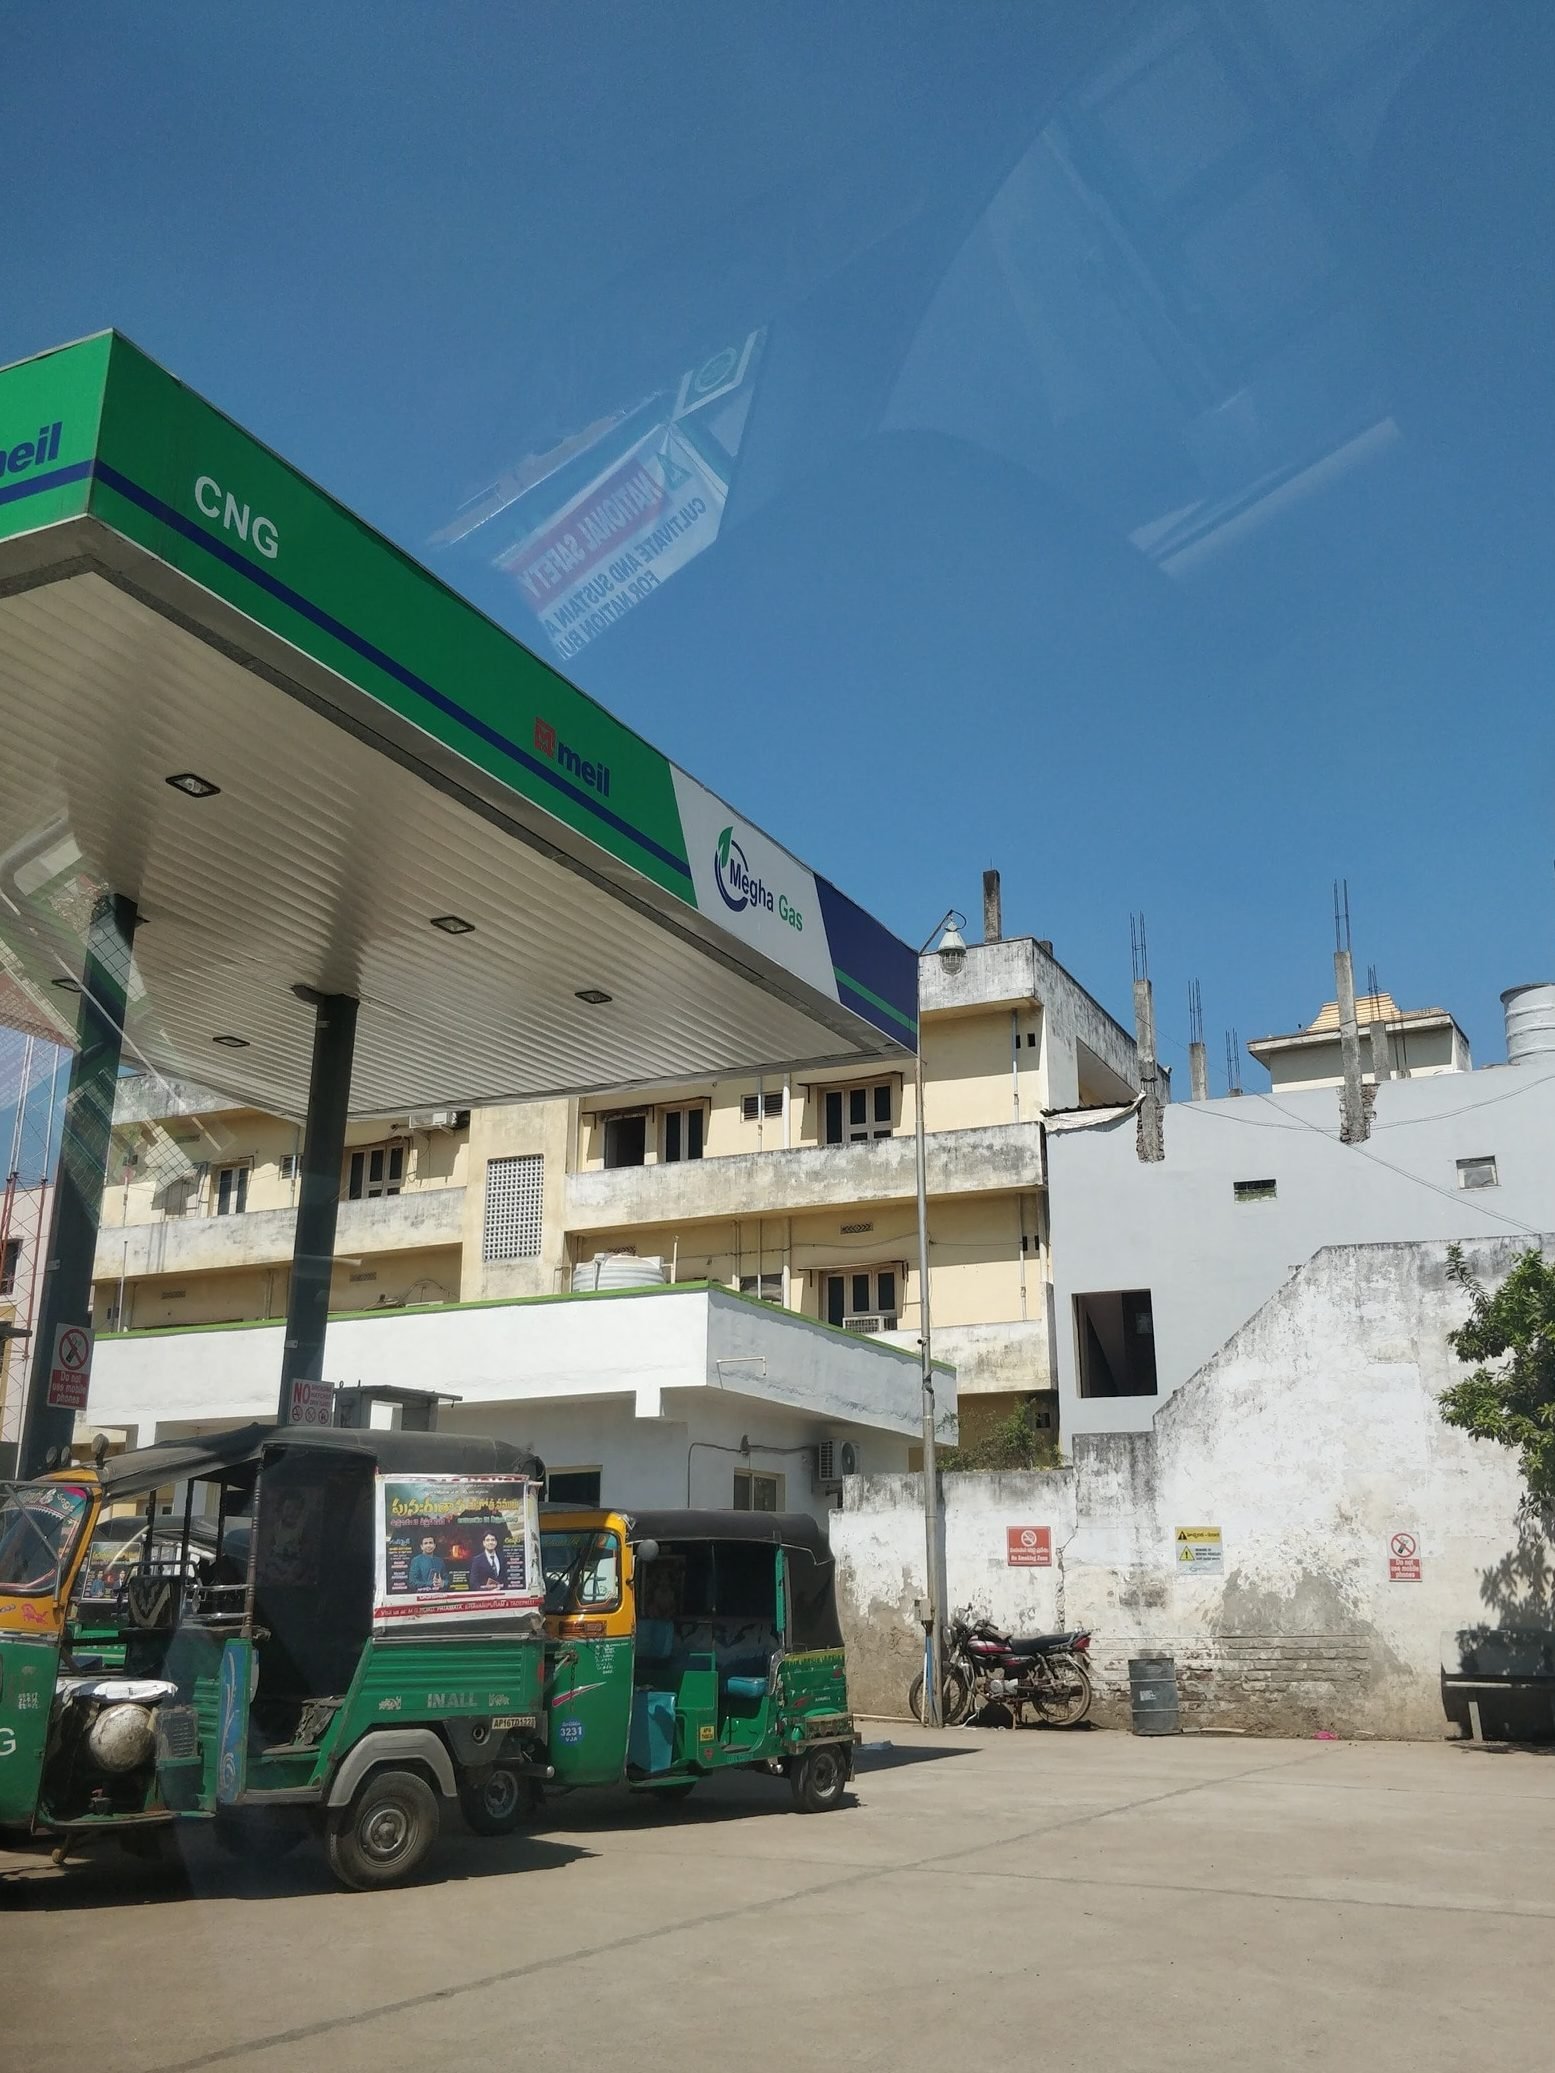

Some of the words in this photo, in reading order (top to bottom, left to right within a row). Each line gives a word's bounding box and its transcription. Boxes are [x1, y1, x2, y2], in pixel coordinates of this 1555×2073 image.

[0, 421, 63, 477] eil
[194, 476, 279, 559] CNG
[557, 741, 610, 797] meil
[729, 858, 774, 912] Megha
[778, 894, 803, 932] Gas
[61, 1371, 70, 1381] Do
[293, 1382, 311, 1404] NO
[560, 1726, 582, 1737] 3231
